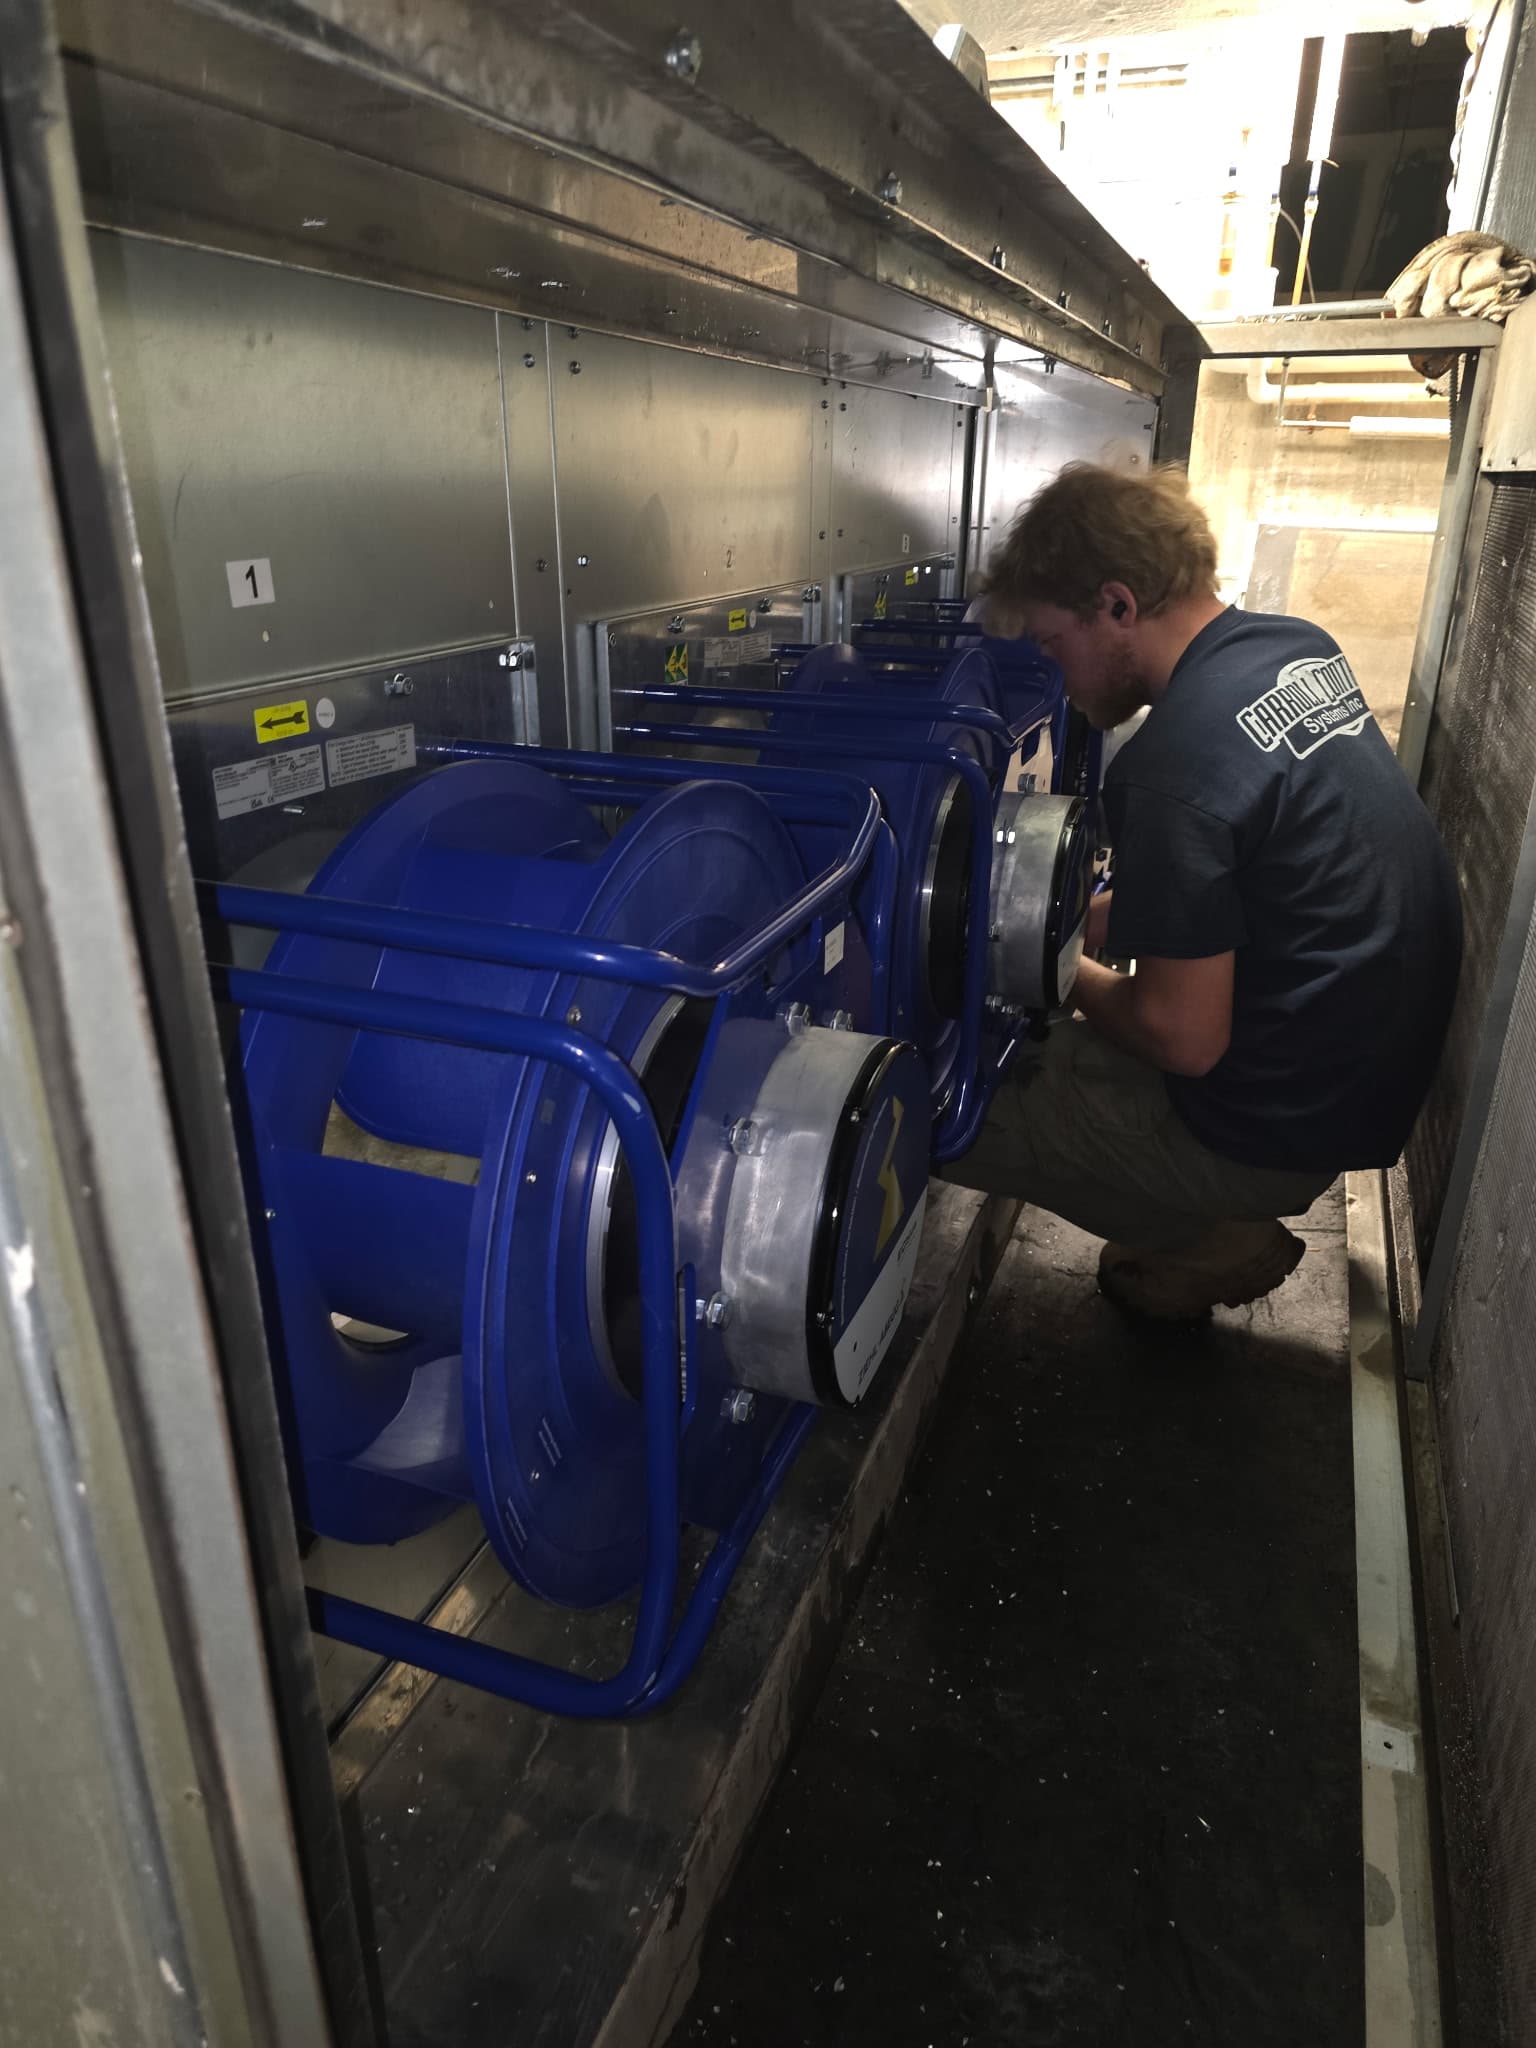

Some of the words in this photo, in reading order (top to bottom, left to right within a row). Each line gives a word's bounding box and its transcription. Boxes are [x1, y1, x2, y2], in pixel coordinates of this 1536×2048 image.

[245, 565, 258, 599] 1
[1240, 678, 1325, 748] CARROLL
[1303, 706, 1350, 734] Systems
[1343, 698, 1363, 714] Inc
